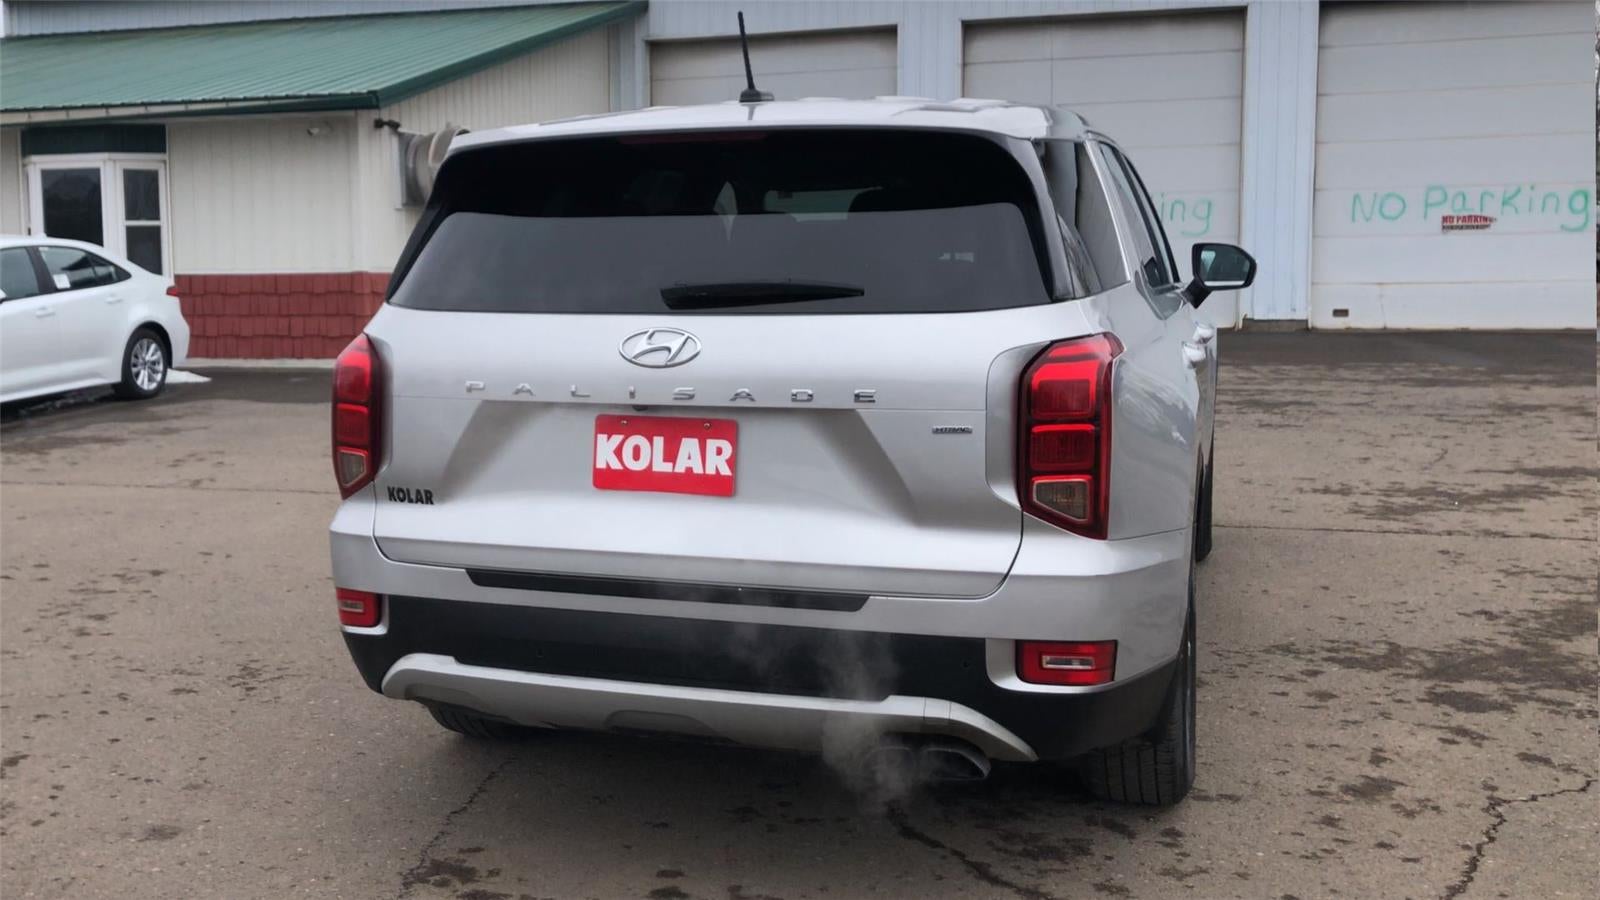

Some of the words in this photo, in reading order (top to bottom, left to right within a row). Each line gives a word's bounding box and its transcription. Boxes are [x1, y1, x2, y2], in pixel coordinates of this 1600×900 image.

[1351, 191, 1407, 223] NO
[1442, 215, 1454, 224] NO
[465, 380, 877, 403] PALISADE
[595, 433, 733, 476] KOLAR
[387, 485, 435, 505] KOLAR
